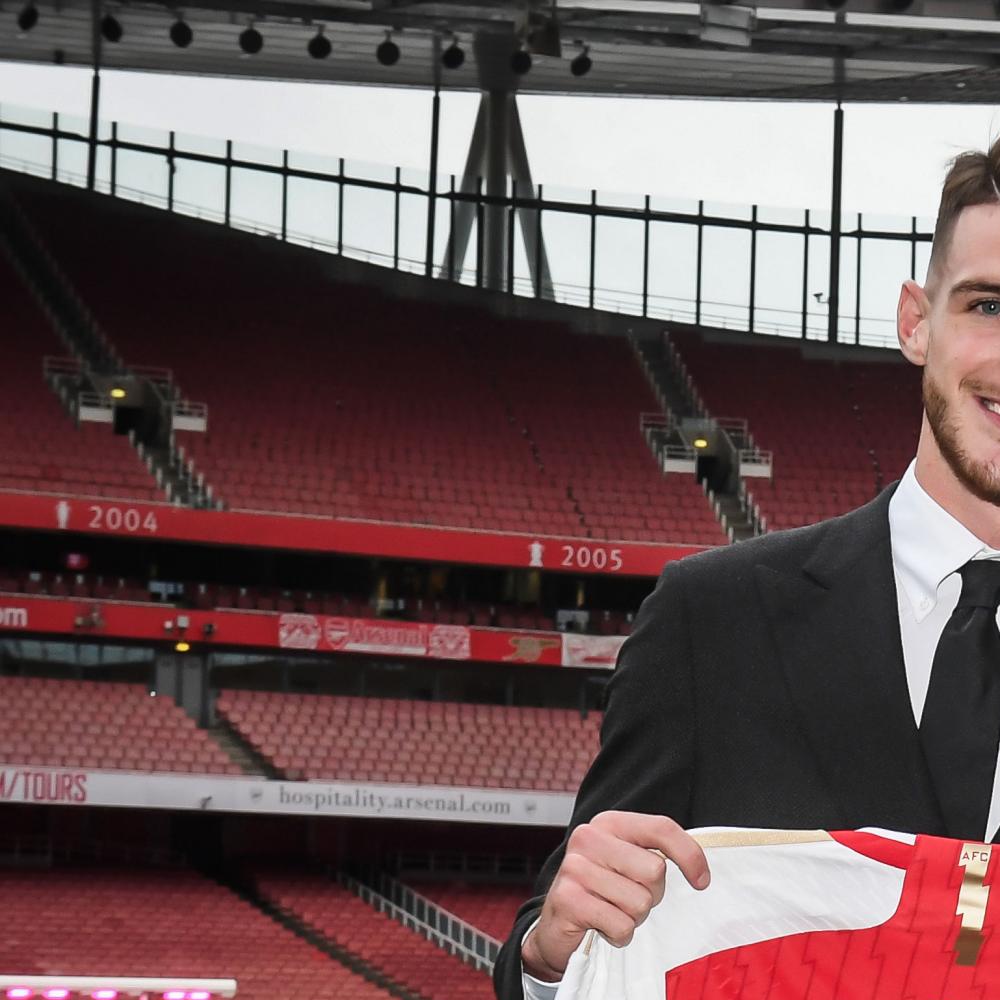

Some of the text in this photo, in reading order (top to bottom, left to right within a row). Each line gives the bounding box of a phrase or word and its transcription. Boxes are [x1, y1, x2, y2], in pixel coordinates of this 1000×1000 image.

[88, 505, 158, 532] 2004
[561, 545, 623, 571] 2005
[280, 785, 511, 815] hospitality.arsenal.com
[961, 851, 989, 862] AFC
